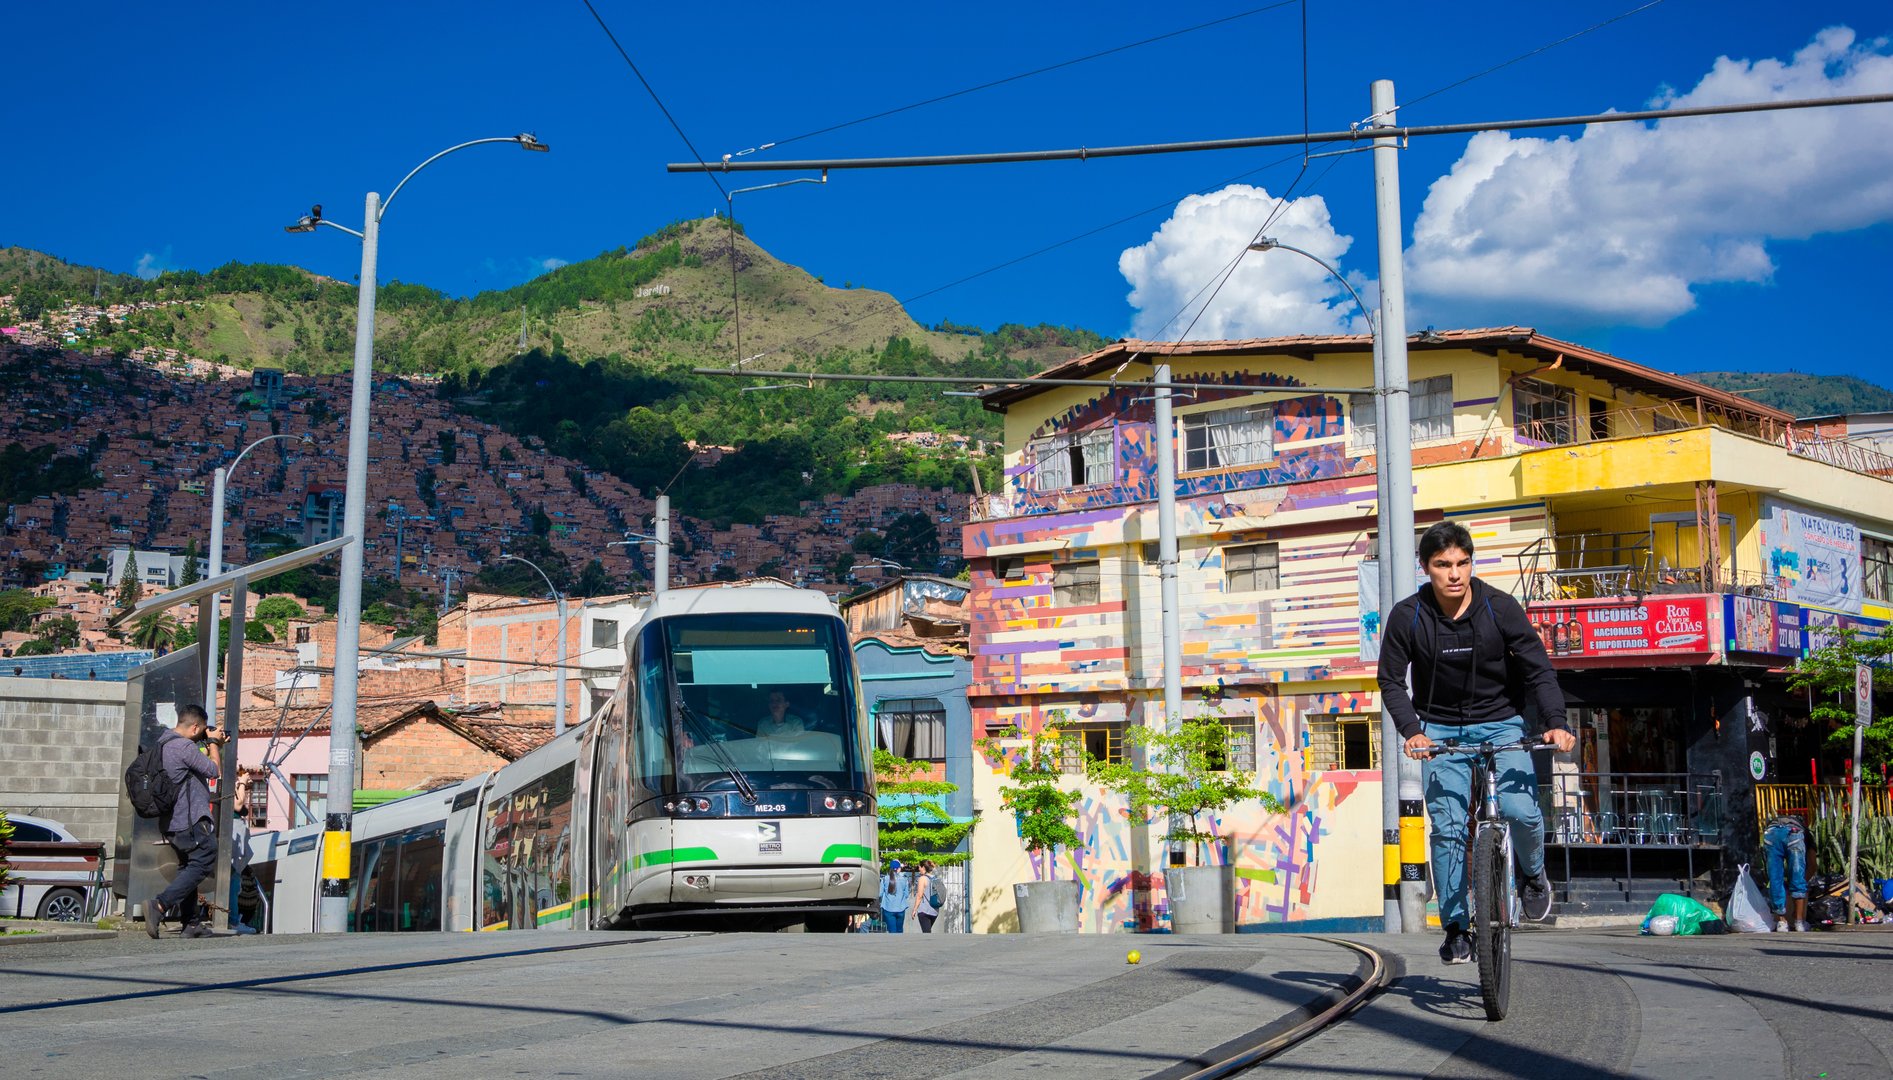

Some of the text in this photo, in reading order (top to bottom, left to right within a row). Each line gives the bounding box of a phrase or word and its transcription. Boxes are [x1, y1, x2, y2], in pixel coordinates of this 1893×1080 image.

[1801, 516, 1830, 535] NATALY
[1804, 531, 1826, 545] CONCEJO
[1840, 557, 1849, 595] 3
[1587, 606, 1649, 623] LICORES
[1593, 626, 1643, 637] NACIONALES
[1655, 620, 1703, 634] CALDAS
[1589, 639, 1649, 650] E IMPORTADOS
[755, 804, 786, 812] ME2-03
